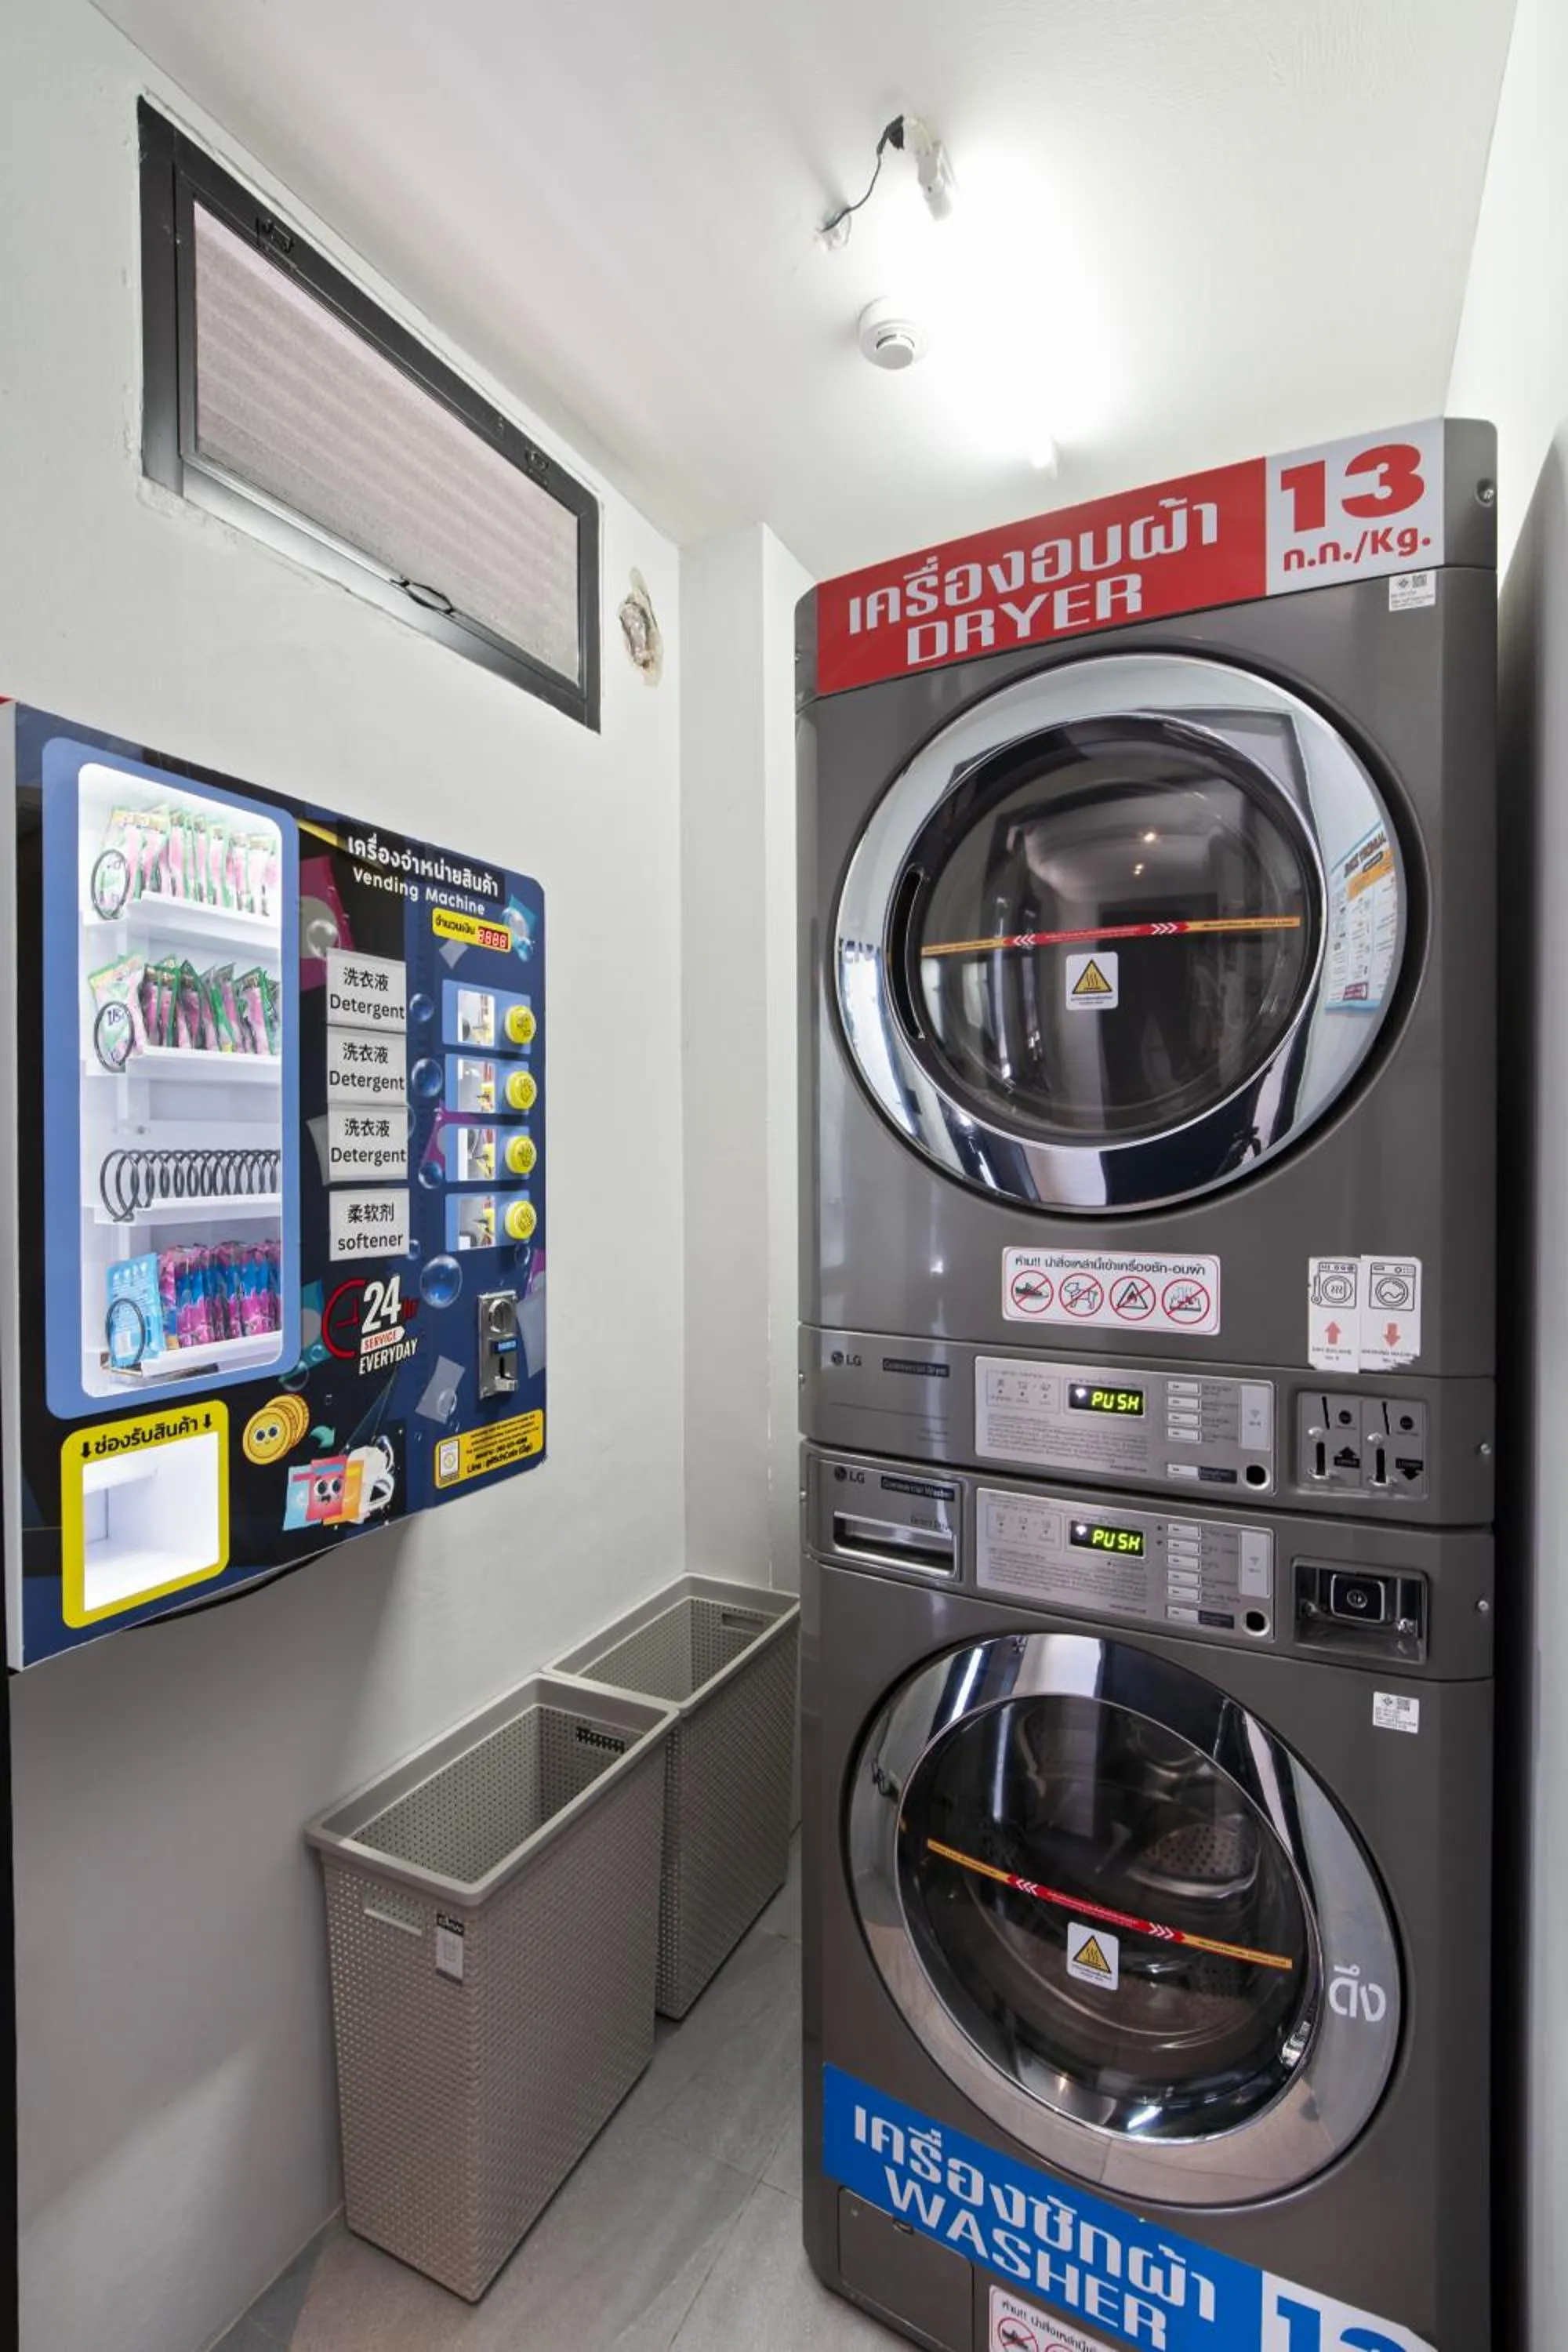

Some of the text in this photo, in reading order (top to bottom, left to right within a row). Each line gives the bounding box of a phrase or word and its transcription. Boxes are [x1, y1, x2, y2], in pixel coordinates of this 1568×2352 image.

[1281, 443, 1426, 533] 13
[1283, 526, 1432, 572] ก.ก./Kg.
[848, 497, 1220, 636] เครื่องอบผ้า
[906, 574, 1142, 666] DRYER
[347, 832, 499, 897] เครื่องจำหน่ายสินค้า
[353, 866, 486, 916] Vending Machine
[343, 966, 389, 992] 洗衣液
[329, 993, 405, 1020] Detergent
[343, 1042, 389, 1065] 洗衣液
[329, 1070, 405, 1093] Detergent
[344, 1117, 390, 1138] 洗衣液
[330, 1147, 406, 1167] Detergent
[347, 1202, 395, 1224] 柔软剂
[338, 1232, 404, 1251] softener
[361, 1274, 401, 1334] 24
[364, 1329, 397, 1351] SERVICE
[359, 1338, 418, 1375] EVERYDAY
[845, 1356, 862, 1367] LG
[1091, 1391, 1140, 1410] PUSH
[95, 1415, 198, 1455] ช่องรับสินค้า
[848, 1471, 865, 1483] LG
[1092, 1530, 1141, 1551] PUSH
[1329, 1965, 1387, 2023] ดึง
[853, 2104, 1216, 2323] เครื่องซักผ้า
[884, 2165, 1167, 2352] WASHER
[1276, 2294, 1409, 2352] 1
